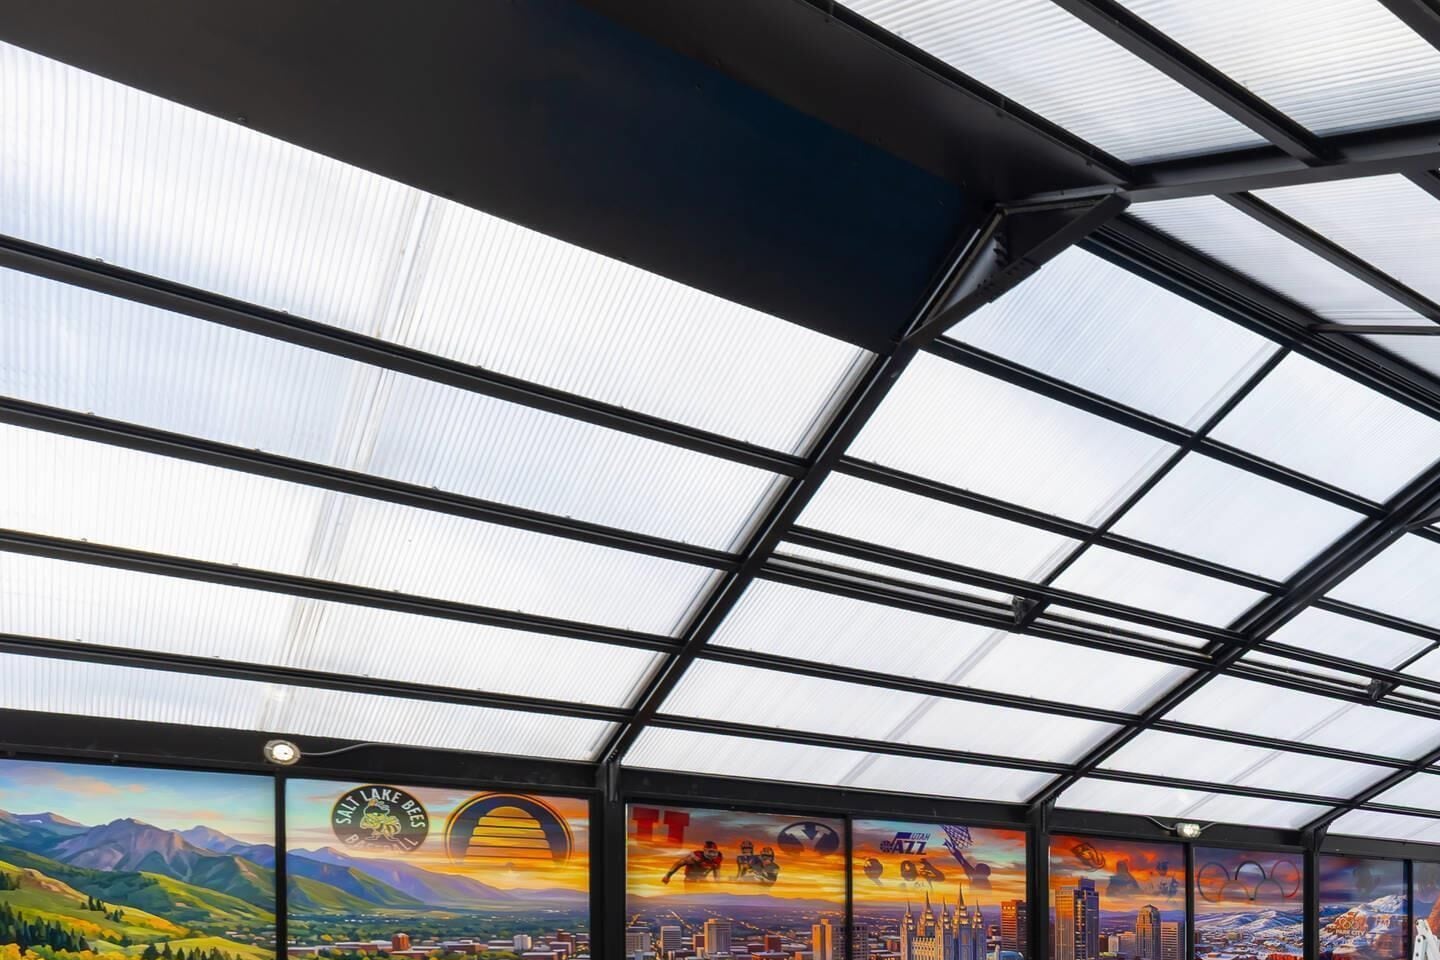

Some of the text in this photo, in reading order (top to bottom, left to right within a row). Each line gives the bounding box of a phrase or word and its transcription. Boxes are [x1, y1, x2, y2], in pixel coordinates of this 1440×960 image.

[336, 788, 426, 828] SALT LAKE BEES
[911, 832, 931, 841] UTAH
